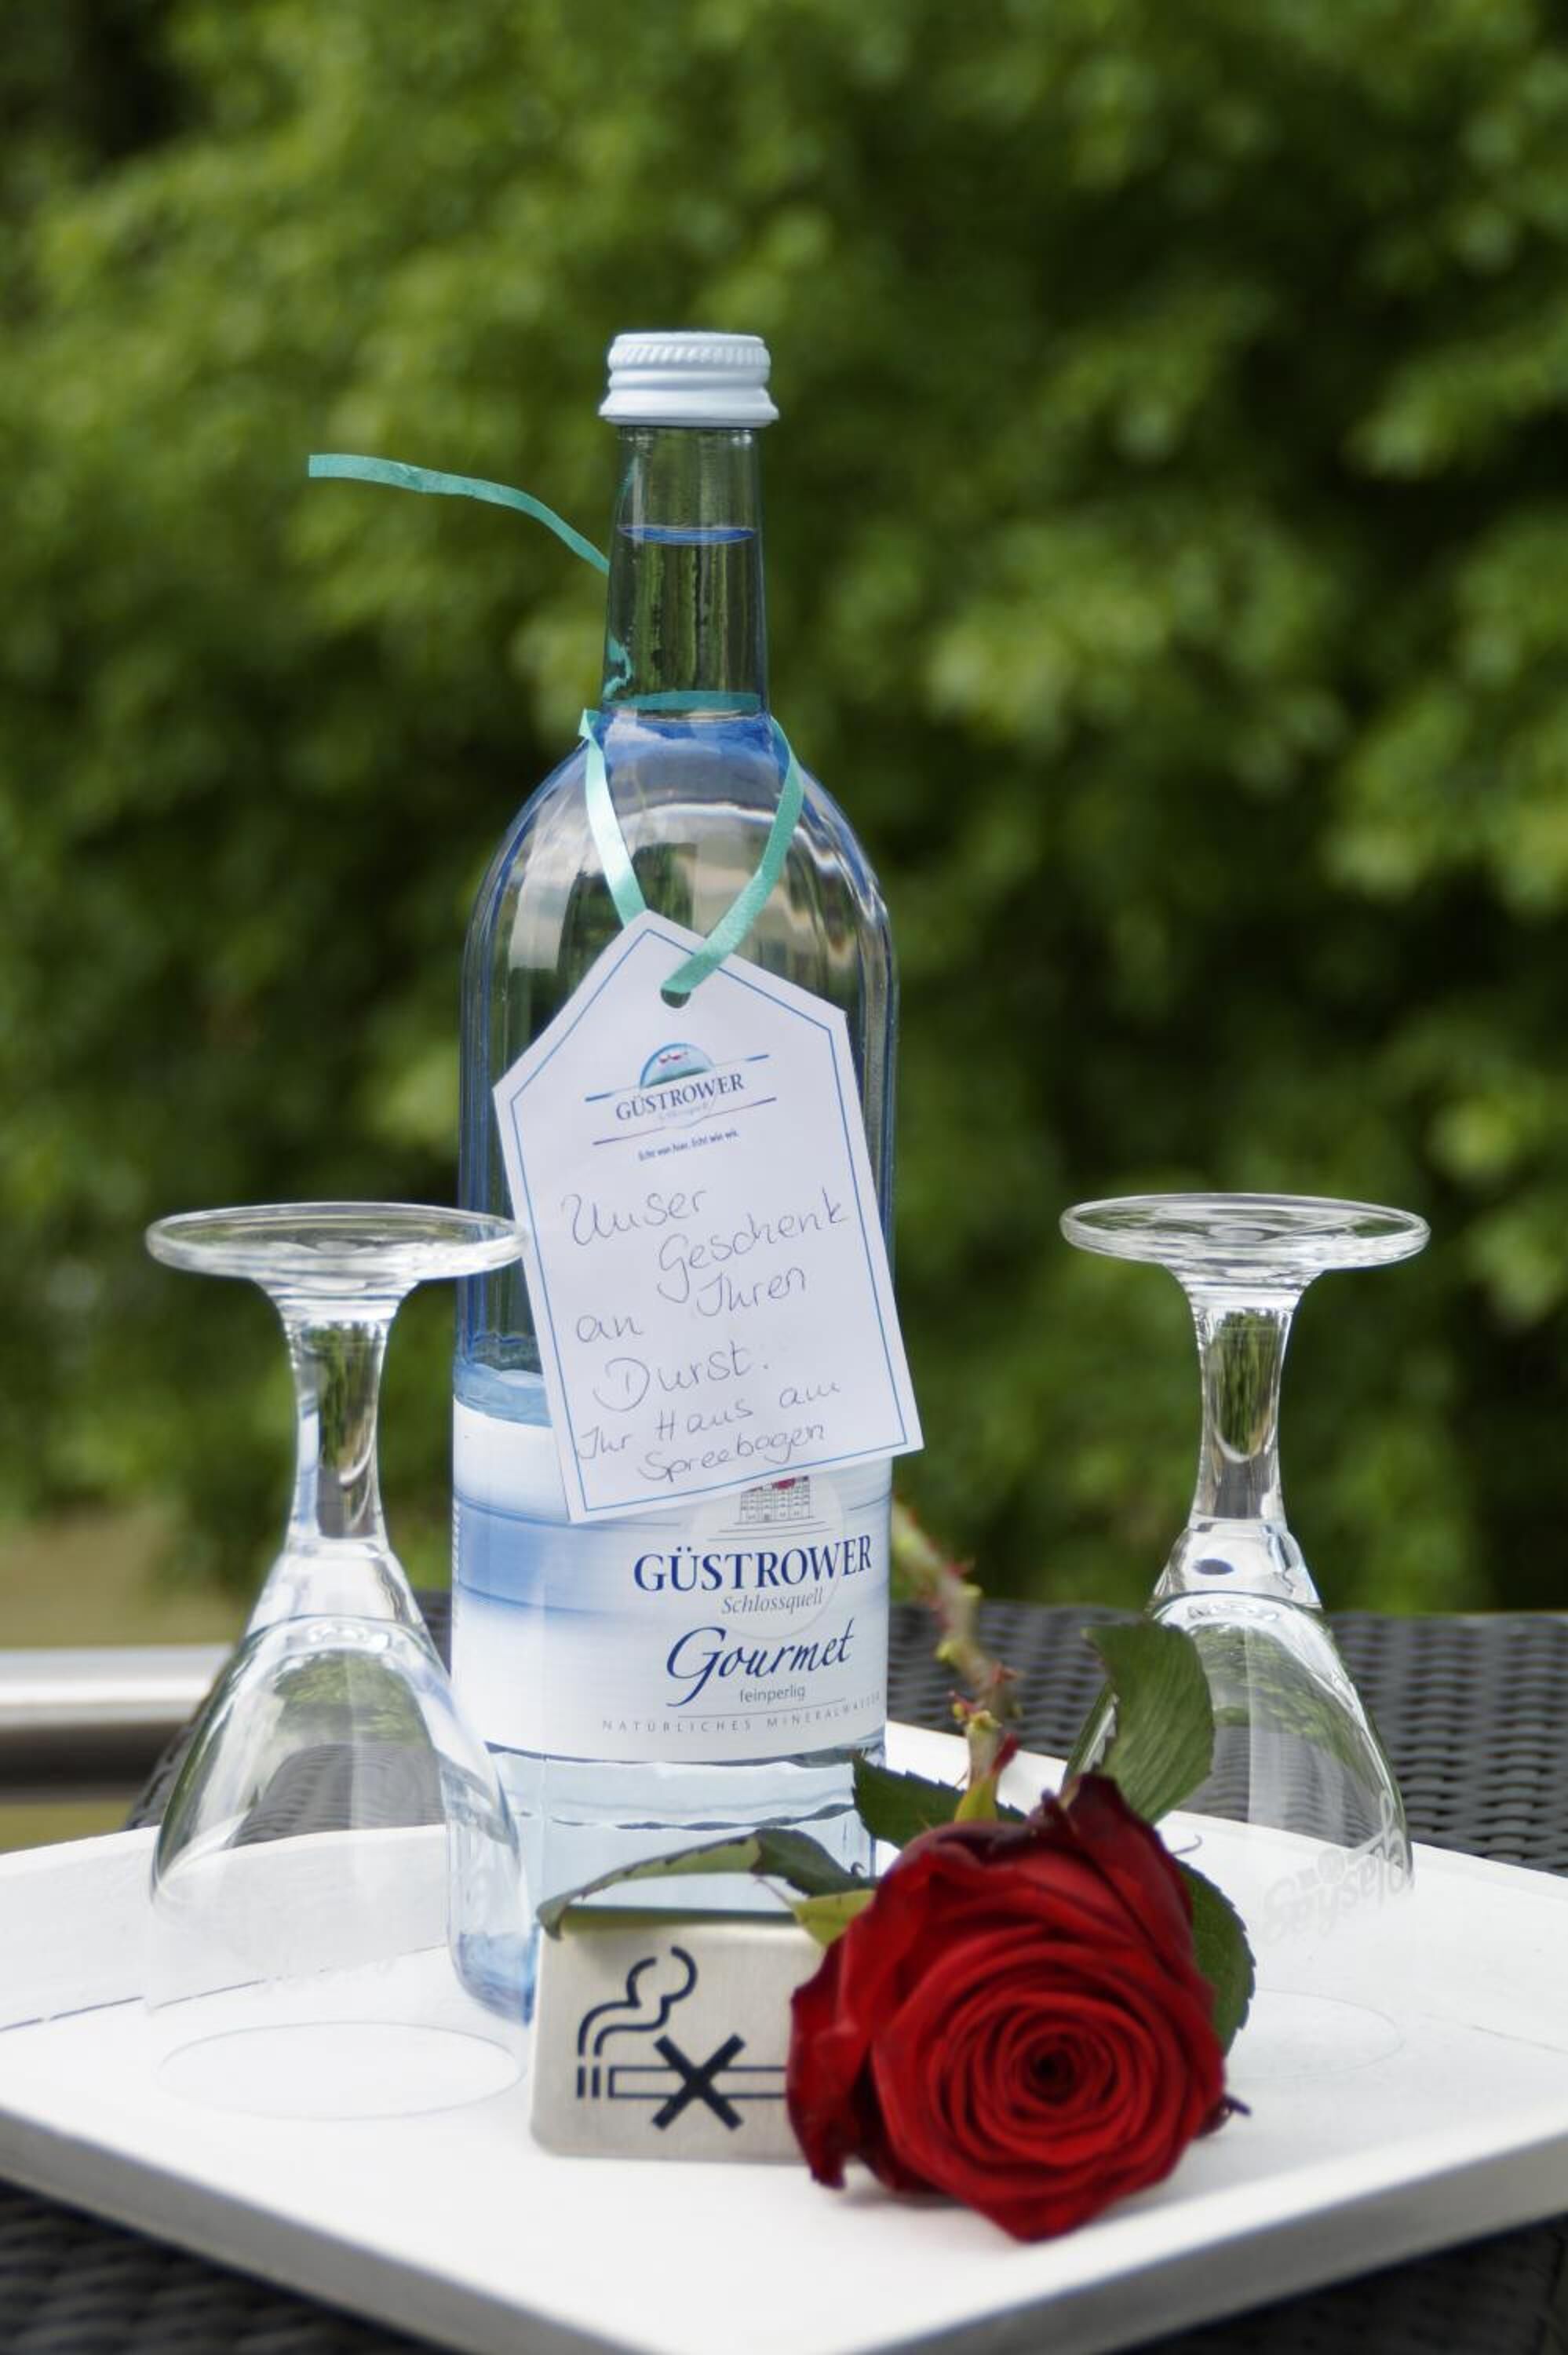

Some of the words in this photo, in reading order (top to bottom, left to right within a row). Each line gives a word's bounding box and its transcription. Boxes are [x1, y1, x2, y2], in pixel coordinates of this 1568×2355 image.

[615, 1073, 745, 1121] GÜSTROWER
[560, 1191, 706, 1246] Unser
[657, 1187, 848, 1303] Geschenk
[575, 1315, 644, 1343] an
[697, 1267, 806, 1317] Ihren
[578, 1426, 633, 1460] Ihr
[655, 1399, 753, 1441] Haus
[779, 1382, 841, 1409] am
[638, 1424, 825, 1483] Spreebogen
[633, 1534, 872, 1592] GÜSTROWER
[720, 1586, 824, 1616] Schlossquell
[665, 1616, 855, 1708] Gourmet
[739, 1684, 807, 1705] feinperlig
[602, 1718, 751, 1732] NATÜRLICHES
